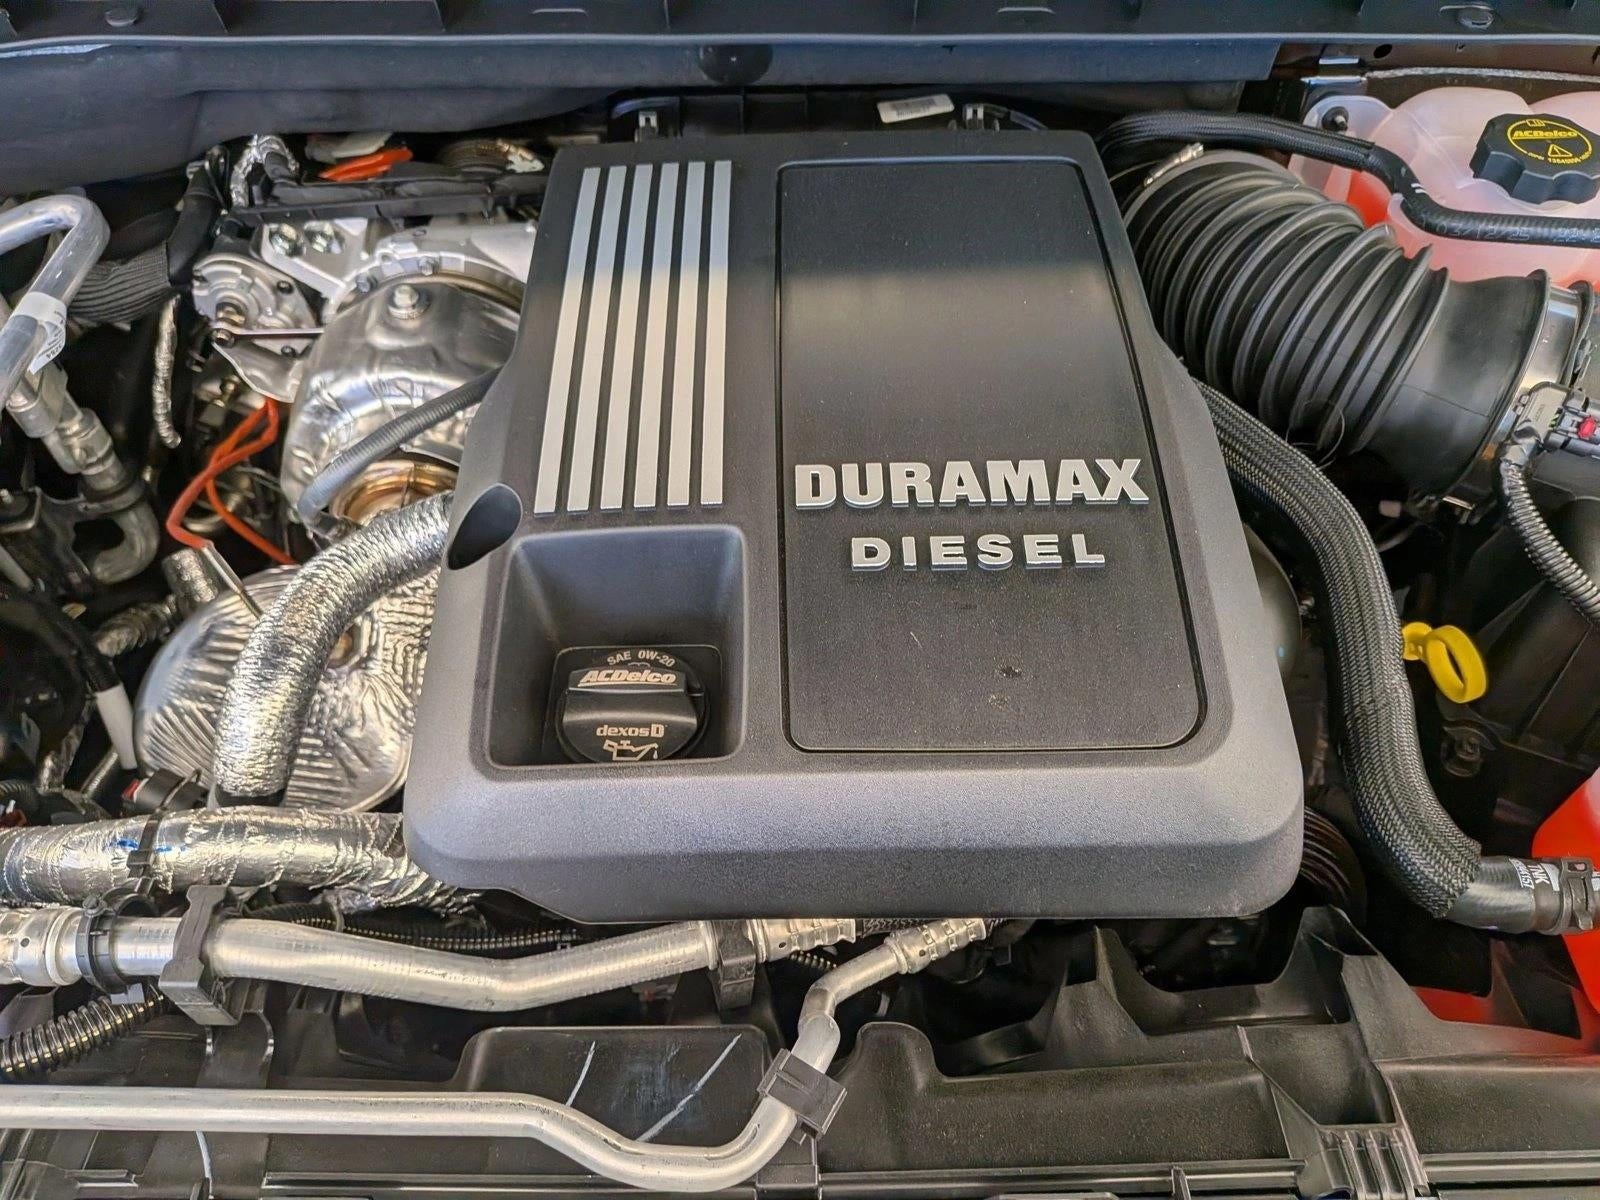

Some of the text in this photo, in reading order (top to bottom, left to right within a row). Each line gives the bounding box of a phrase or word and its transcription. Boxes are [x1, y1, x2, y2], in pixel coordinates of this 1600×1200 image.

[1512, 130, 1578, 138] ACDelco
[795, 459, 1150, 509] DURAMAX
[851, 533, 1106, 571] DIESEL
[606, 650, 676, 668] SAE 0W-20
[580, 669, 677, 684] ACDelco
[596, 724, 665, 738] dexosD
